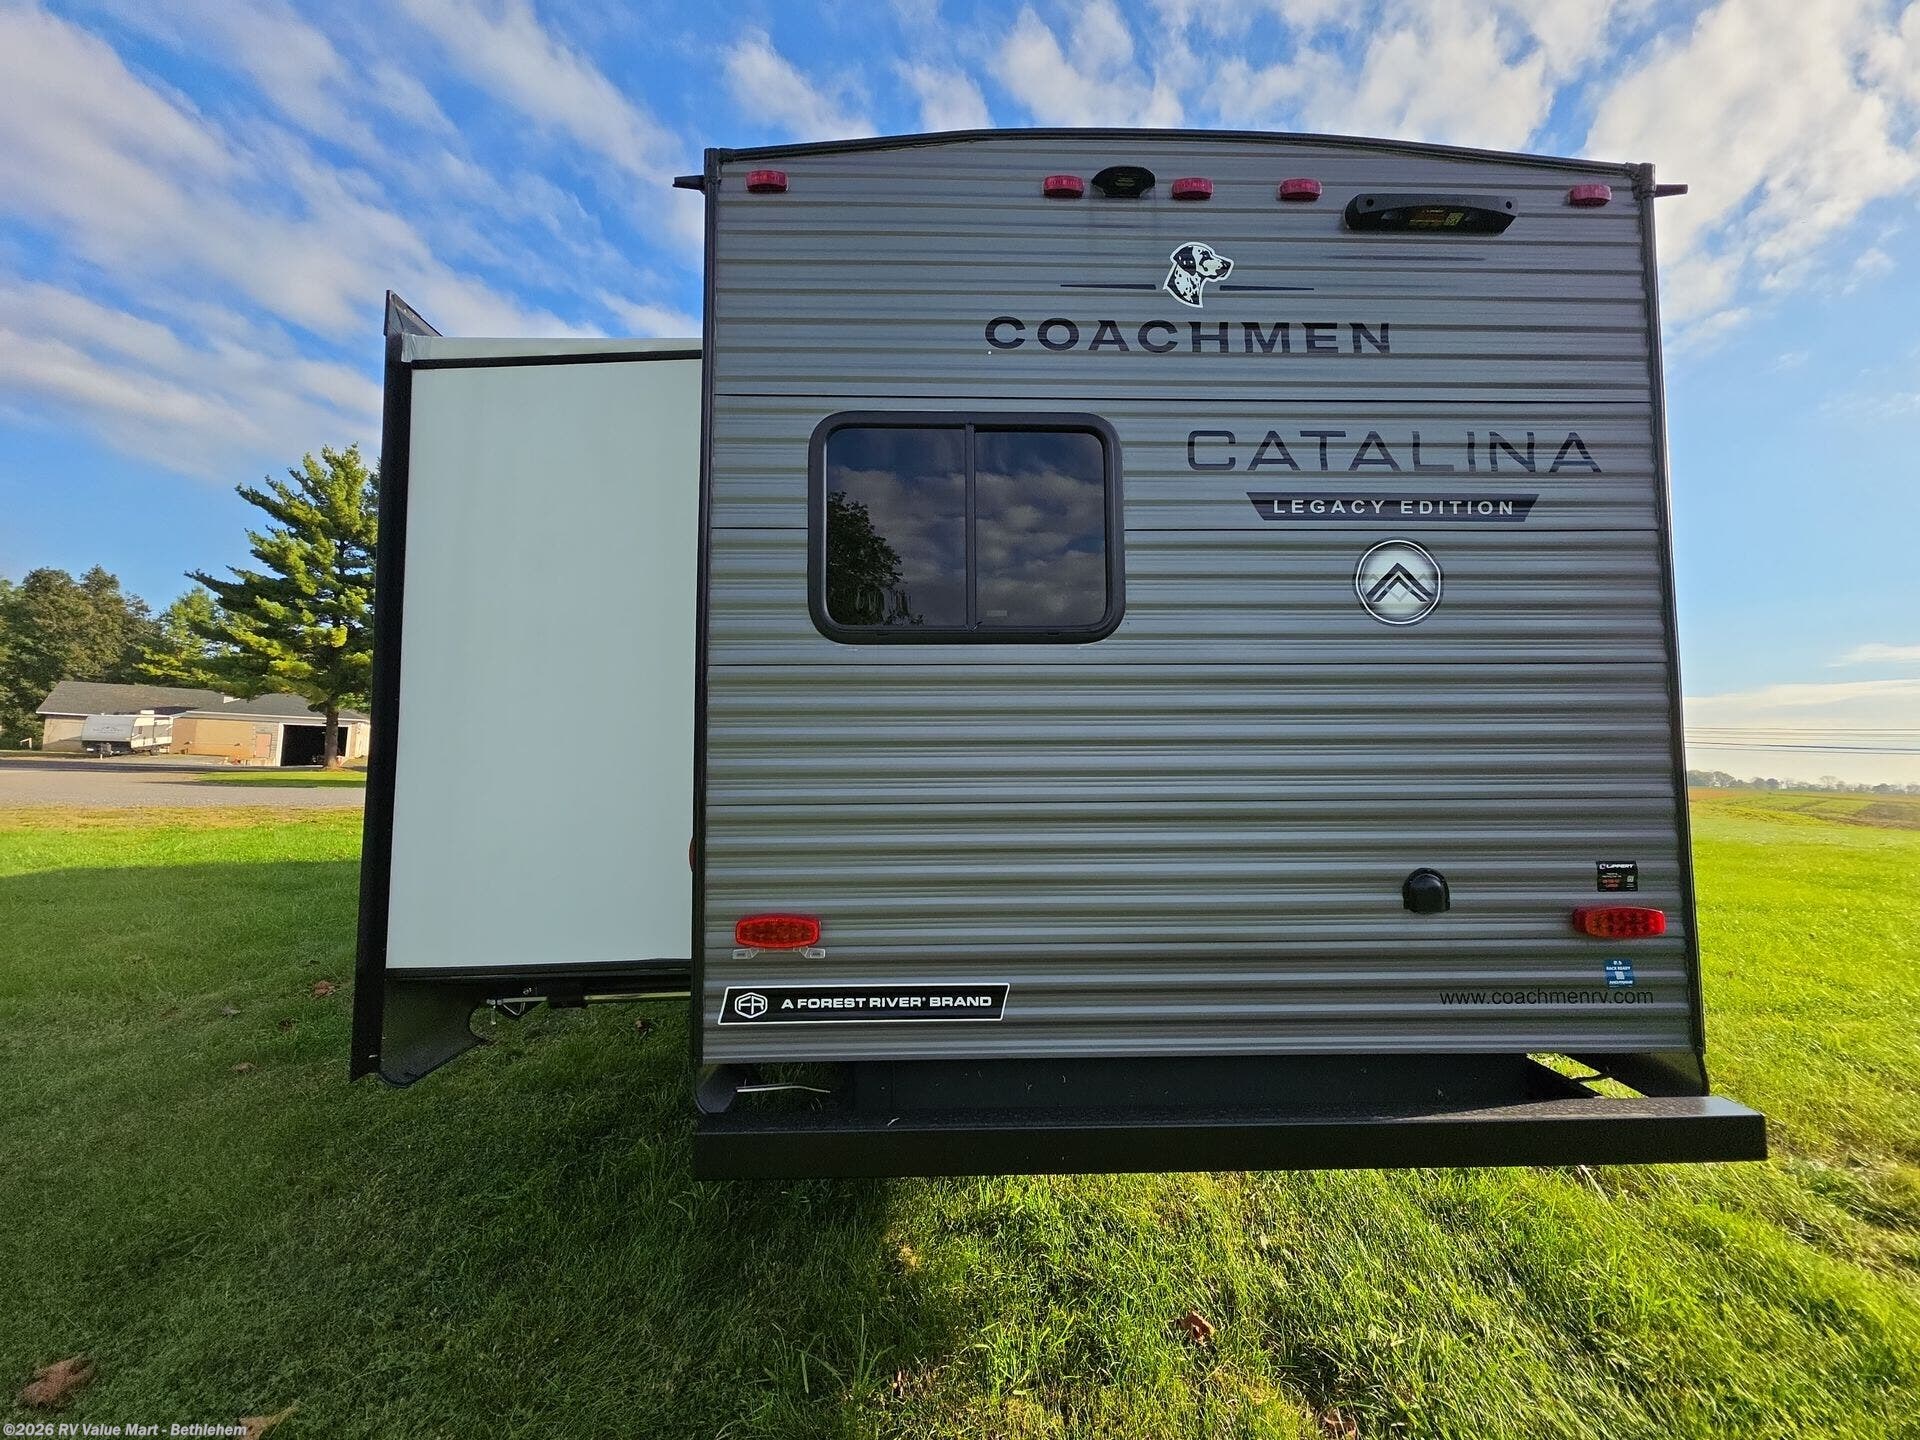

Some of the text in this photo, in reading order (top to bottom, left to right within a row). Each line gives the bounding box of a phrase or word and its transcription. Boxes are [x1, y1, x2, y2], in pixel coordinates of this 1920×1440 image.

[985, 316, 1390, 355] COACHMEN
[1187, 430, 1602, 473] CATALINA
[1273, 499, 1515, 516] LEGACY EDITION
[781, 999, 794, 1009] A
[797, 997, 866, 1009] FOREST
[929, 996, 992, 1007] BRAND
[1440, 988, 1654, 1005] www.coachmenrv.com
